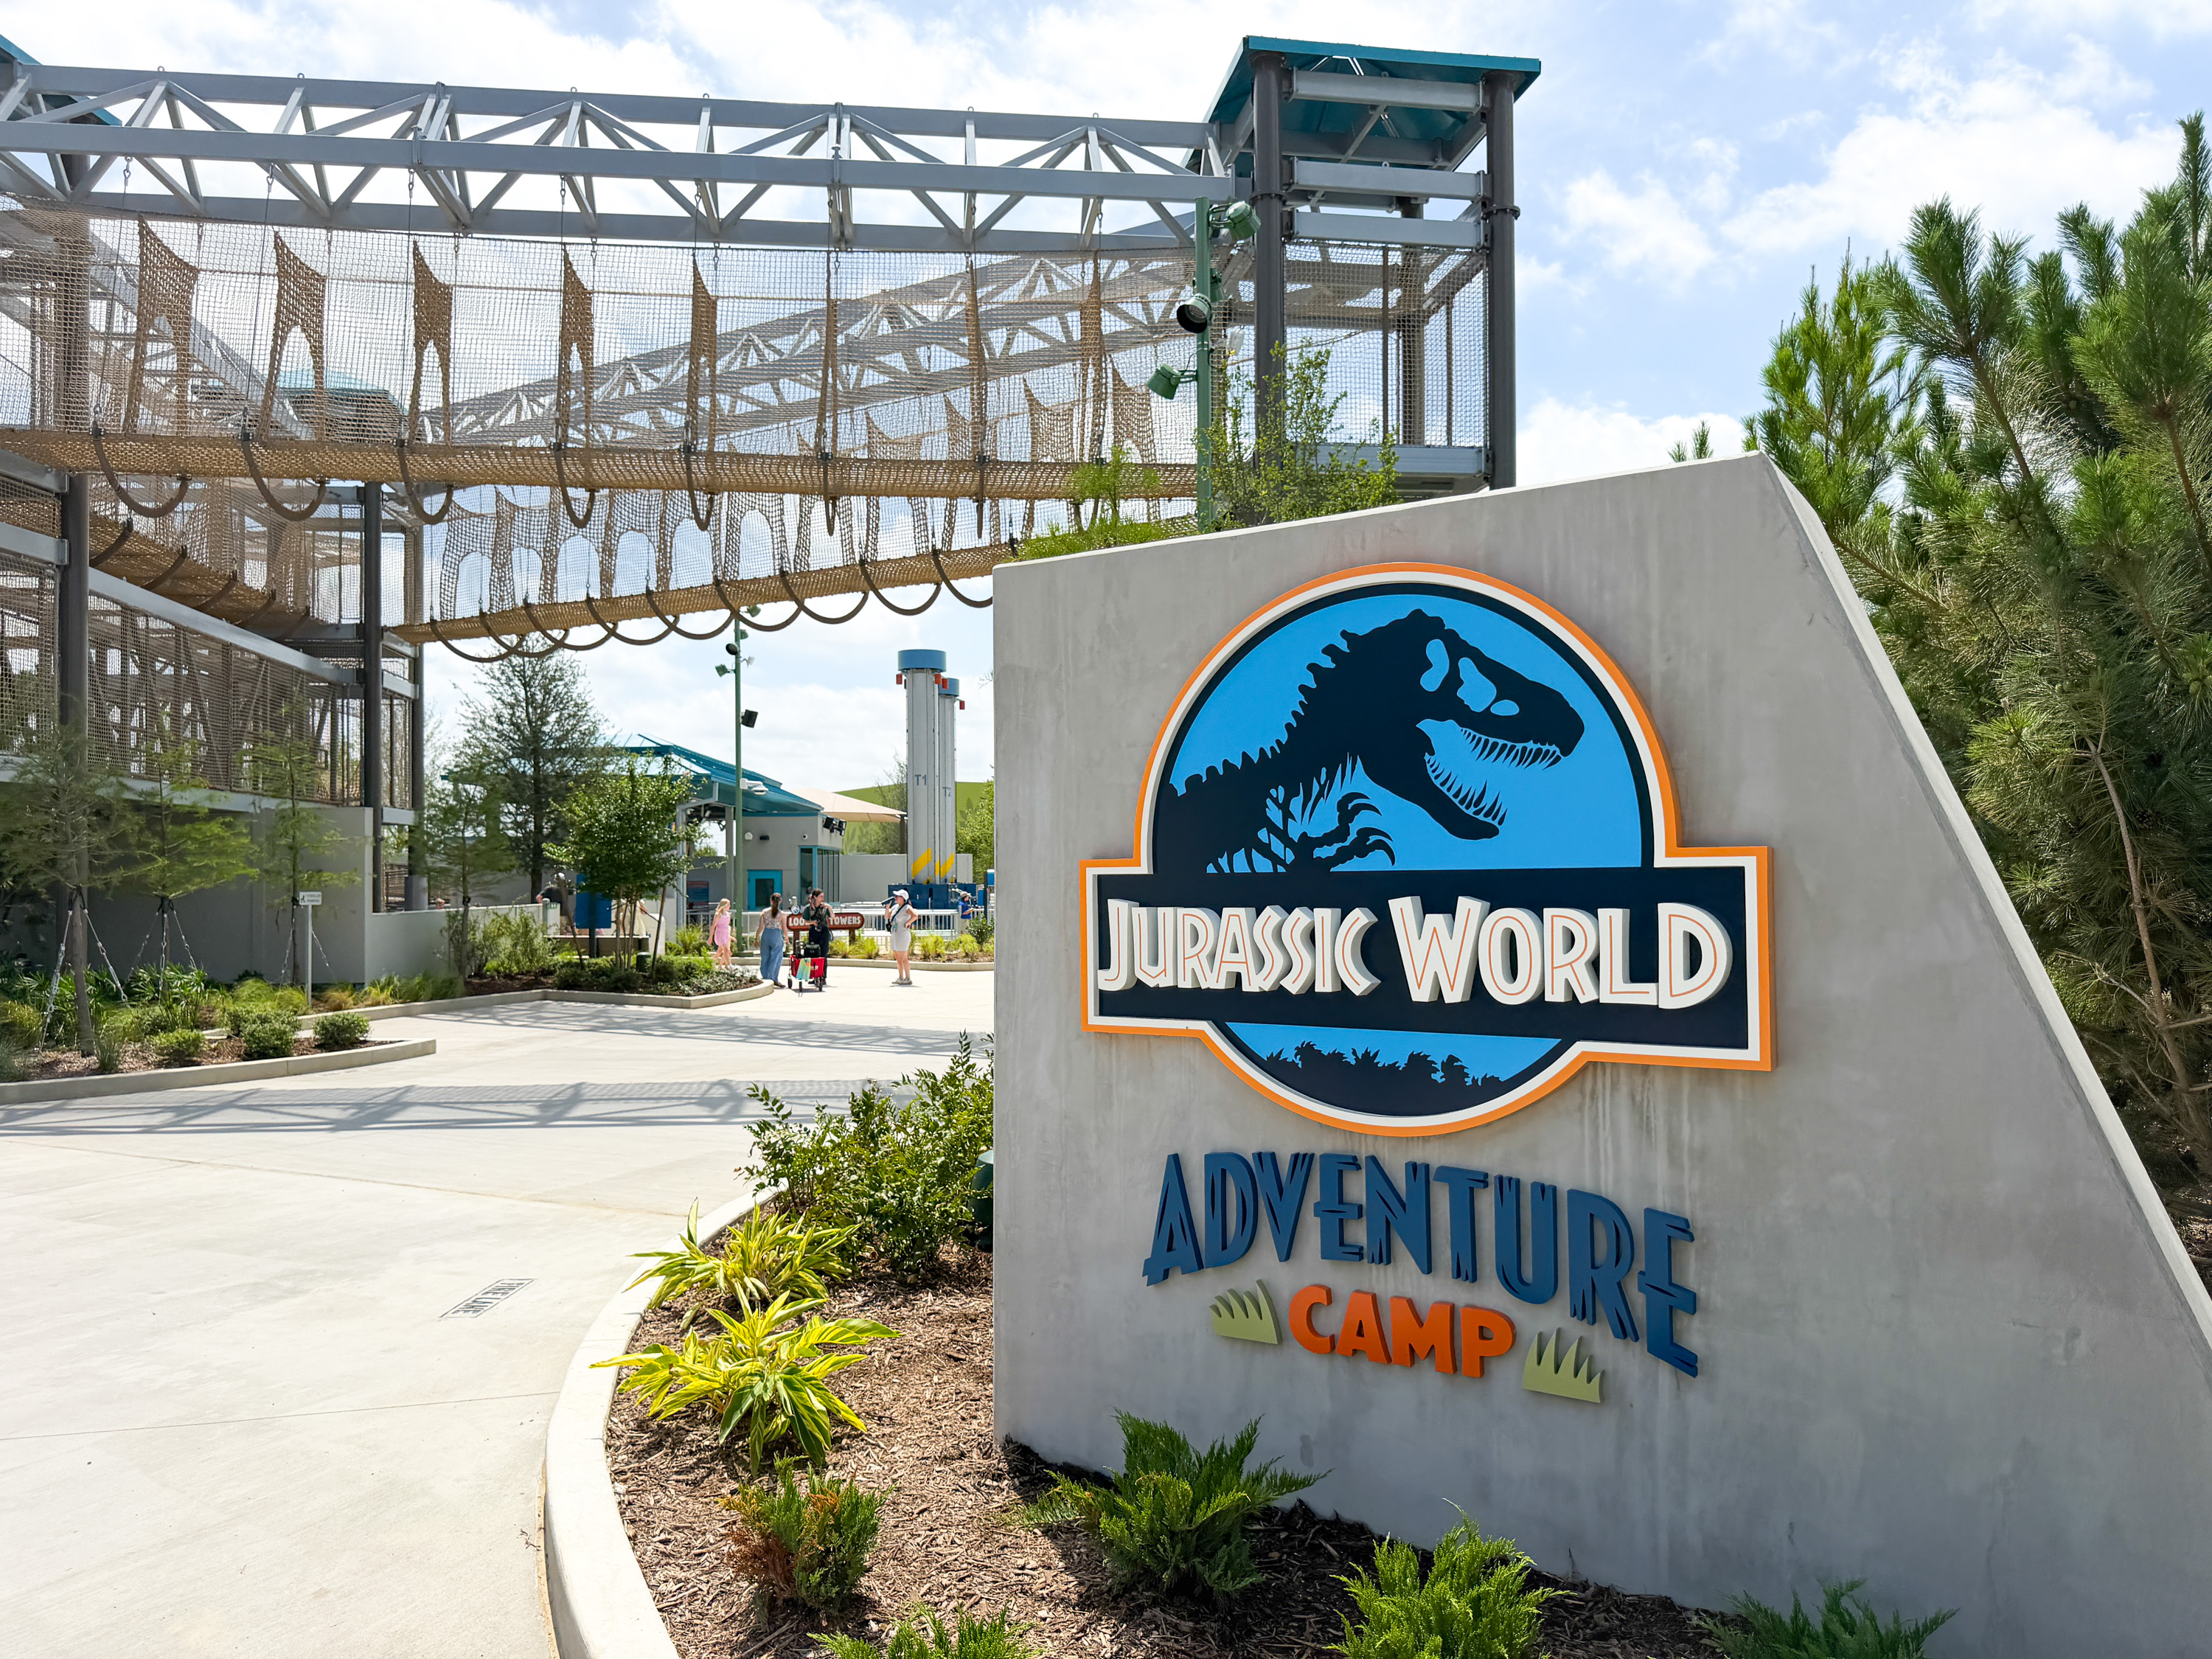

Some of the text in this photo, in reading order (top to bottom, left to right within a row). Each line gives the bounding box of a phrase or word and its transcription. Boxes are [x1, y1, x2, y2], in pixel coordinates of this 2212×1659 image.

[914, 774, 926, 786] T1
[830, 917, 861, 926] TOWERS
[1097, 896, 1733, 1009] JURASSIC WORLD
[1142, 1152, 1698, 1377] ADVENTURE
[451, 1282, 525, 1315] FIRE LANE
[1288, 1284, 1516, 1378] CAMP
